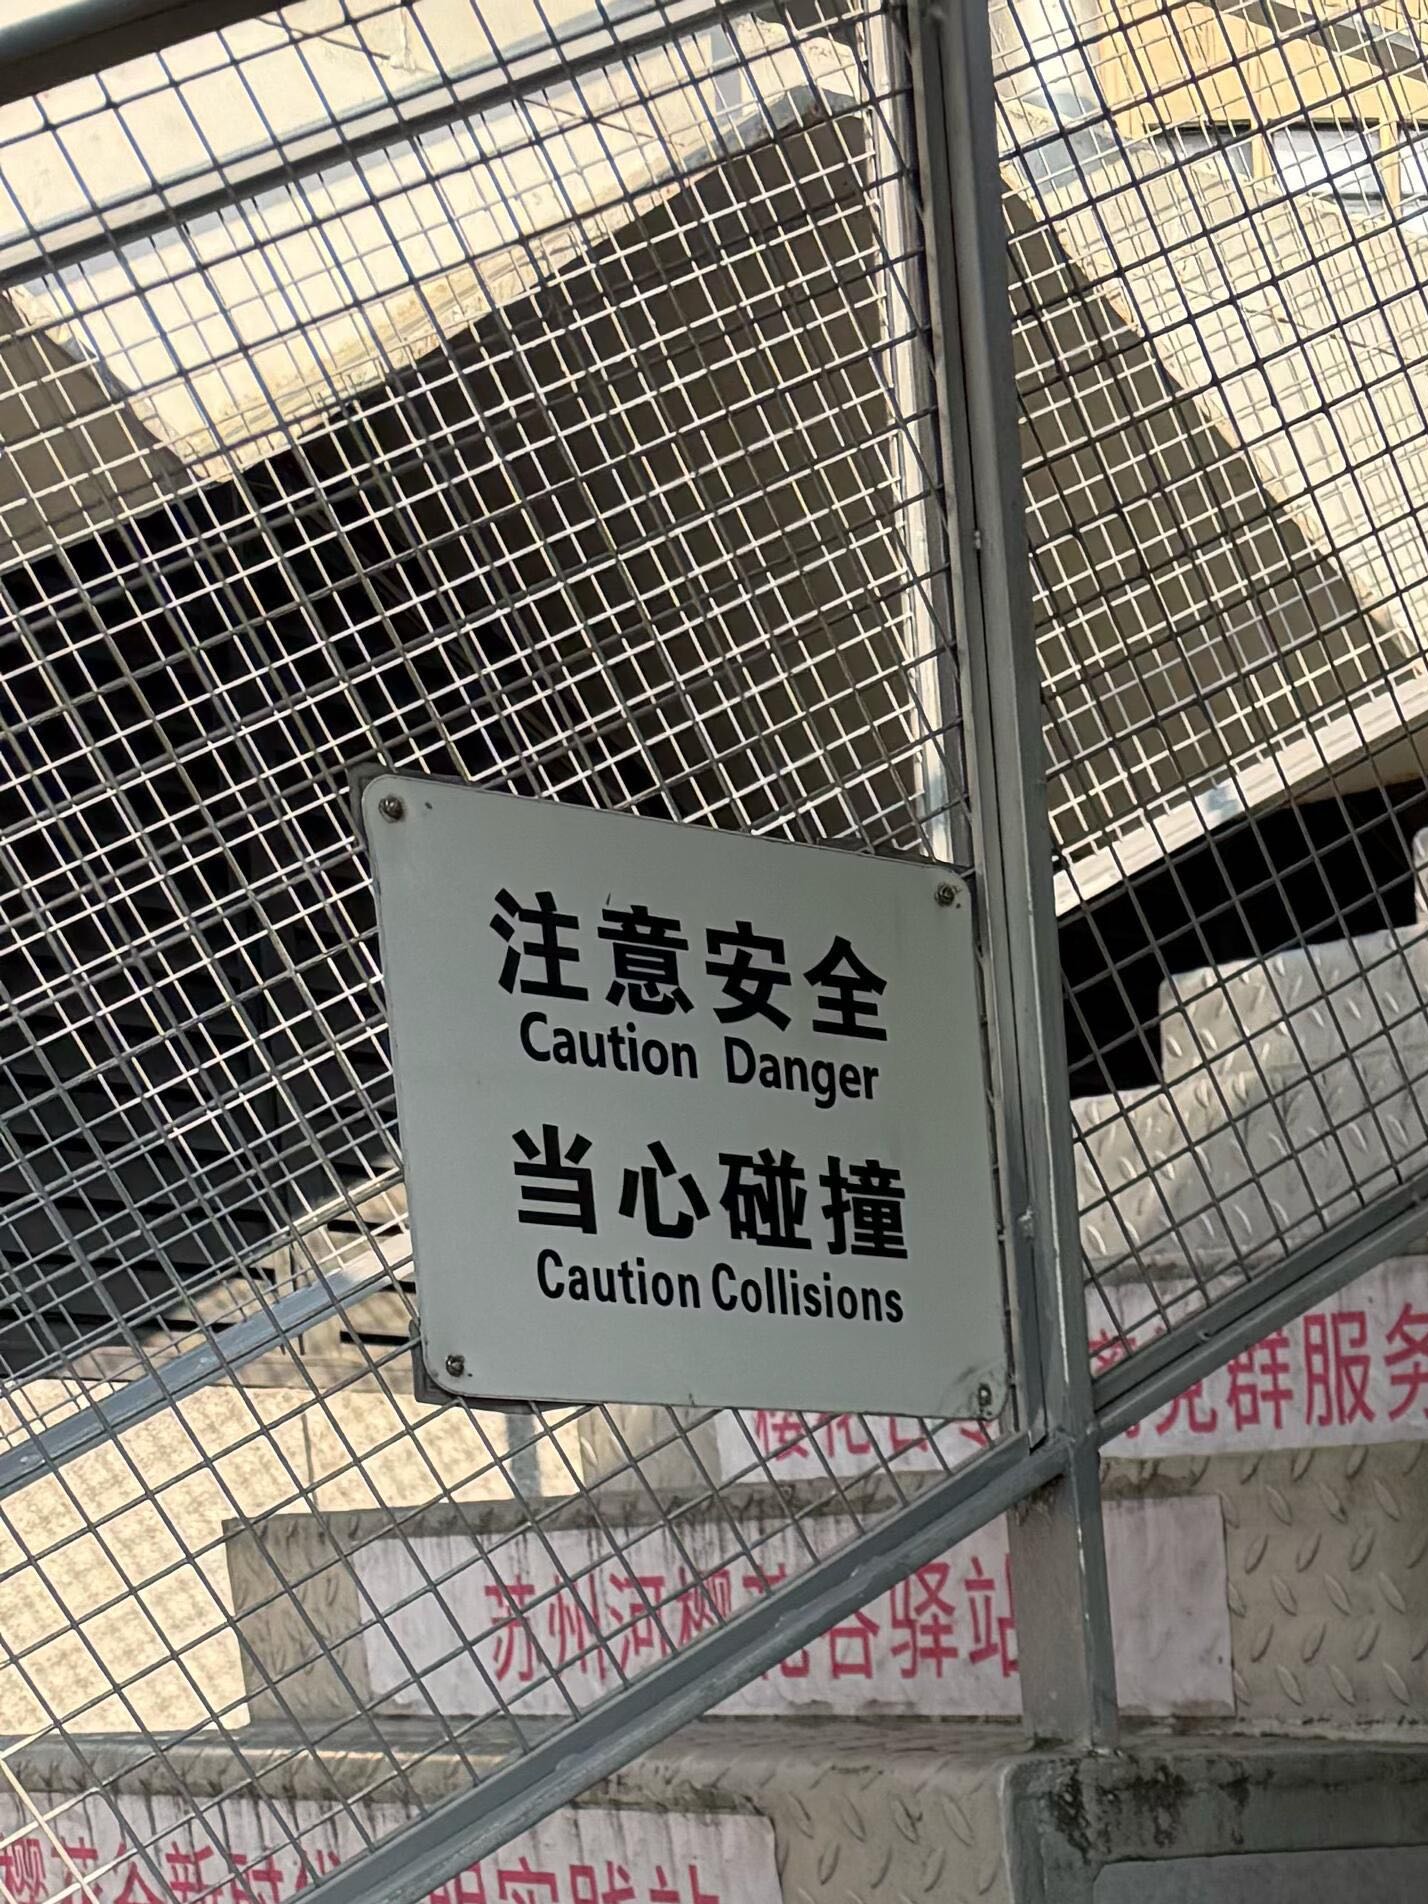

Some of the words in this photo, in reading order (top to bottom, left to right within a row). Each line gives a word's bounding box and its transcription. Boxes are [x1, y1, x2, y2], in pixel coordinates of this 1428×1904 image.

[489, 887, 888, 1041] 注意安全
[520, 1011, 698, 1079] Caution
[725, 1036, 879, 1109] Danger
[512, 1124, 909, 1260] 当心碰撞
[537, 1248, 700, 1309] Caution
[712, 1262, 904, 1323] Collisions
